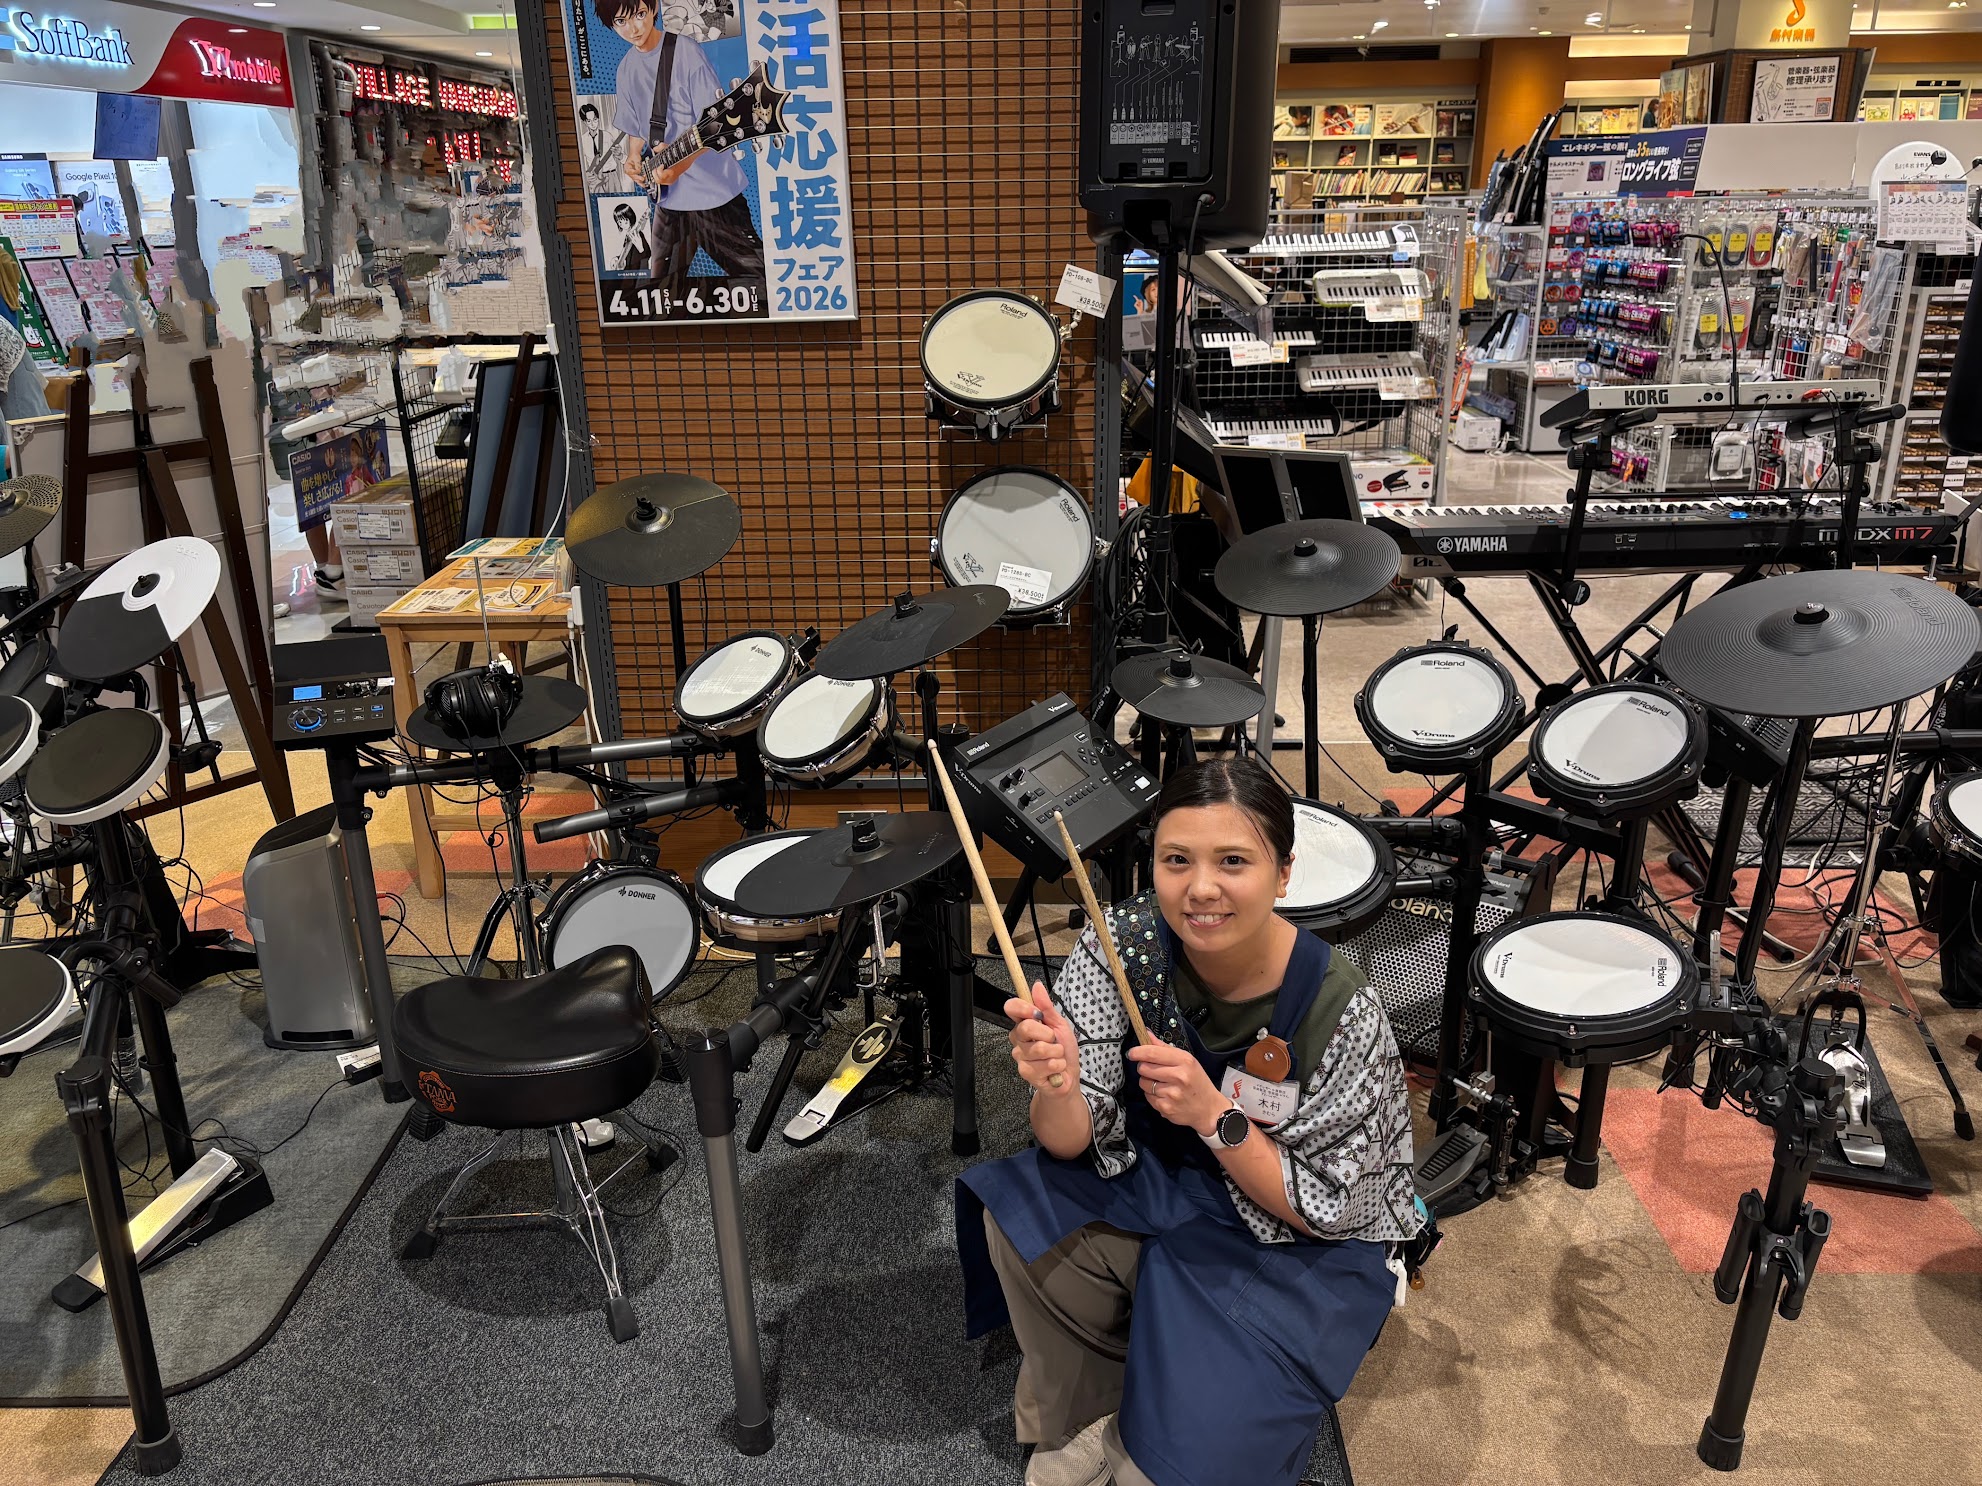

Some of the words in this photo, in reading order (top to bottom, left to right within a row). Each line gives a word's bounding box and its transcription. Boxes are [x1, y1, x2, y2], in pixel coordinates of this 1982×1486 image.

[15, 11, 136, 66] SoftBank
[190, 40, 282, 84] Y!mobile
[1786, 74, 1835, 86] 修理承ります
[66, 173, 92, 181] Google
[94, 172, 110, 180] Pixel
[1622, 158, 1681, 181] ロングライフ弦
[773, 255, 845, 282] フェア
[776, 285, 848, 311] 2026
[1000, 303, 1028, 318] Roland
[1624, 389, 1669, 406] KORG
[292, 452, 312, 465] CASIO
[1061, 498, 1081, 522] Roland
[1454, 536, 1508, 552] YAMAHA
[754, 647, 772, 658] DONNER
[833, 680, 855, 688] DONNER
[1638, 700, 1671, 717] Roland
[1310, 813, 1338, 827] Roland
[628, 890, 656, 900] DONNER
[1657, 966, 1667, 987] Roland
[424, 1082, 458, 1104] TAMA
[1258, 1098, 1281, 1111] 木村
